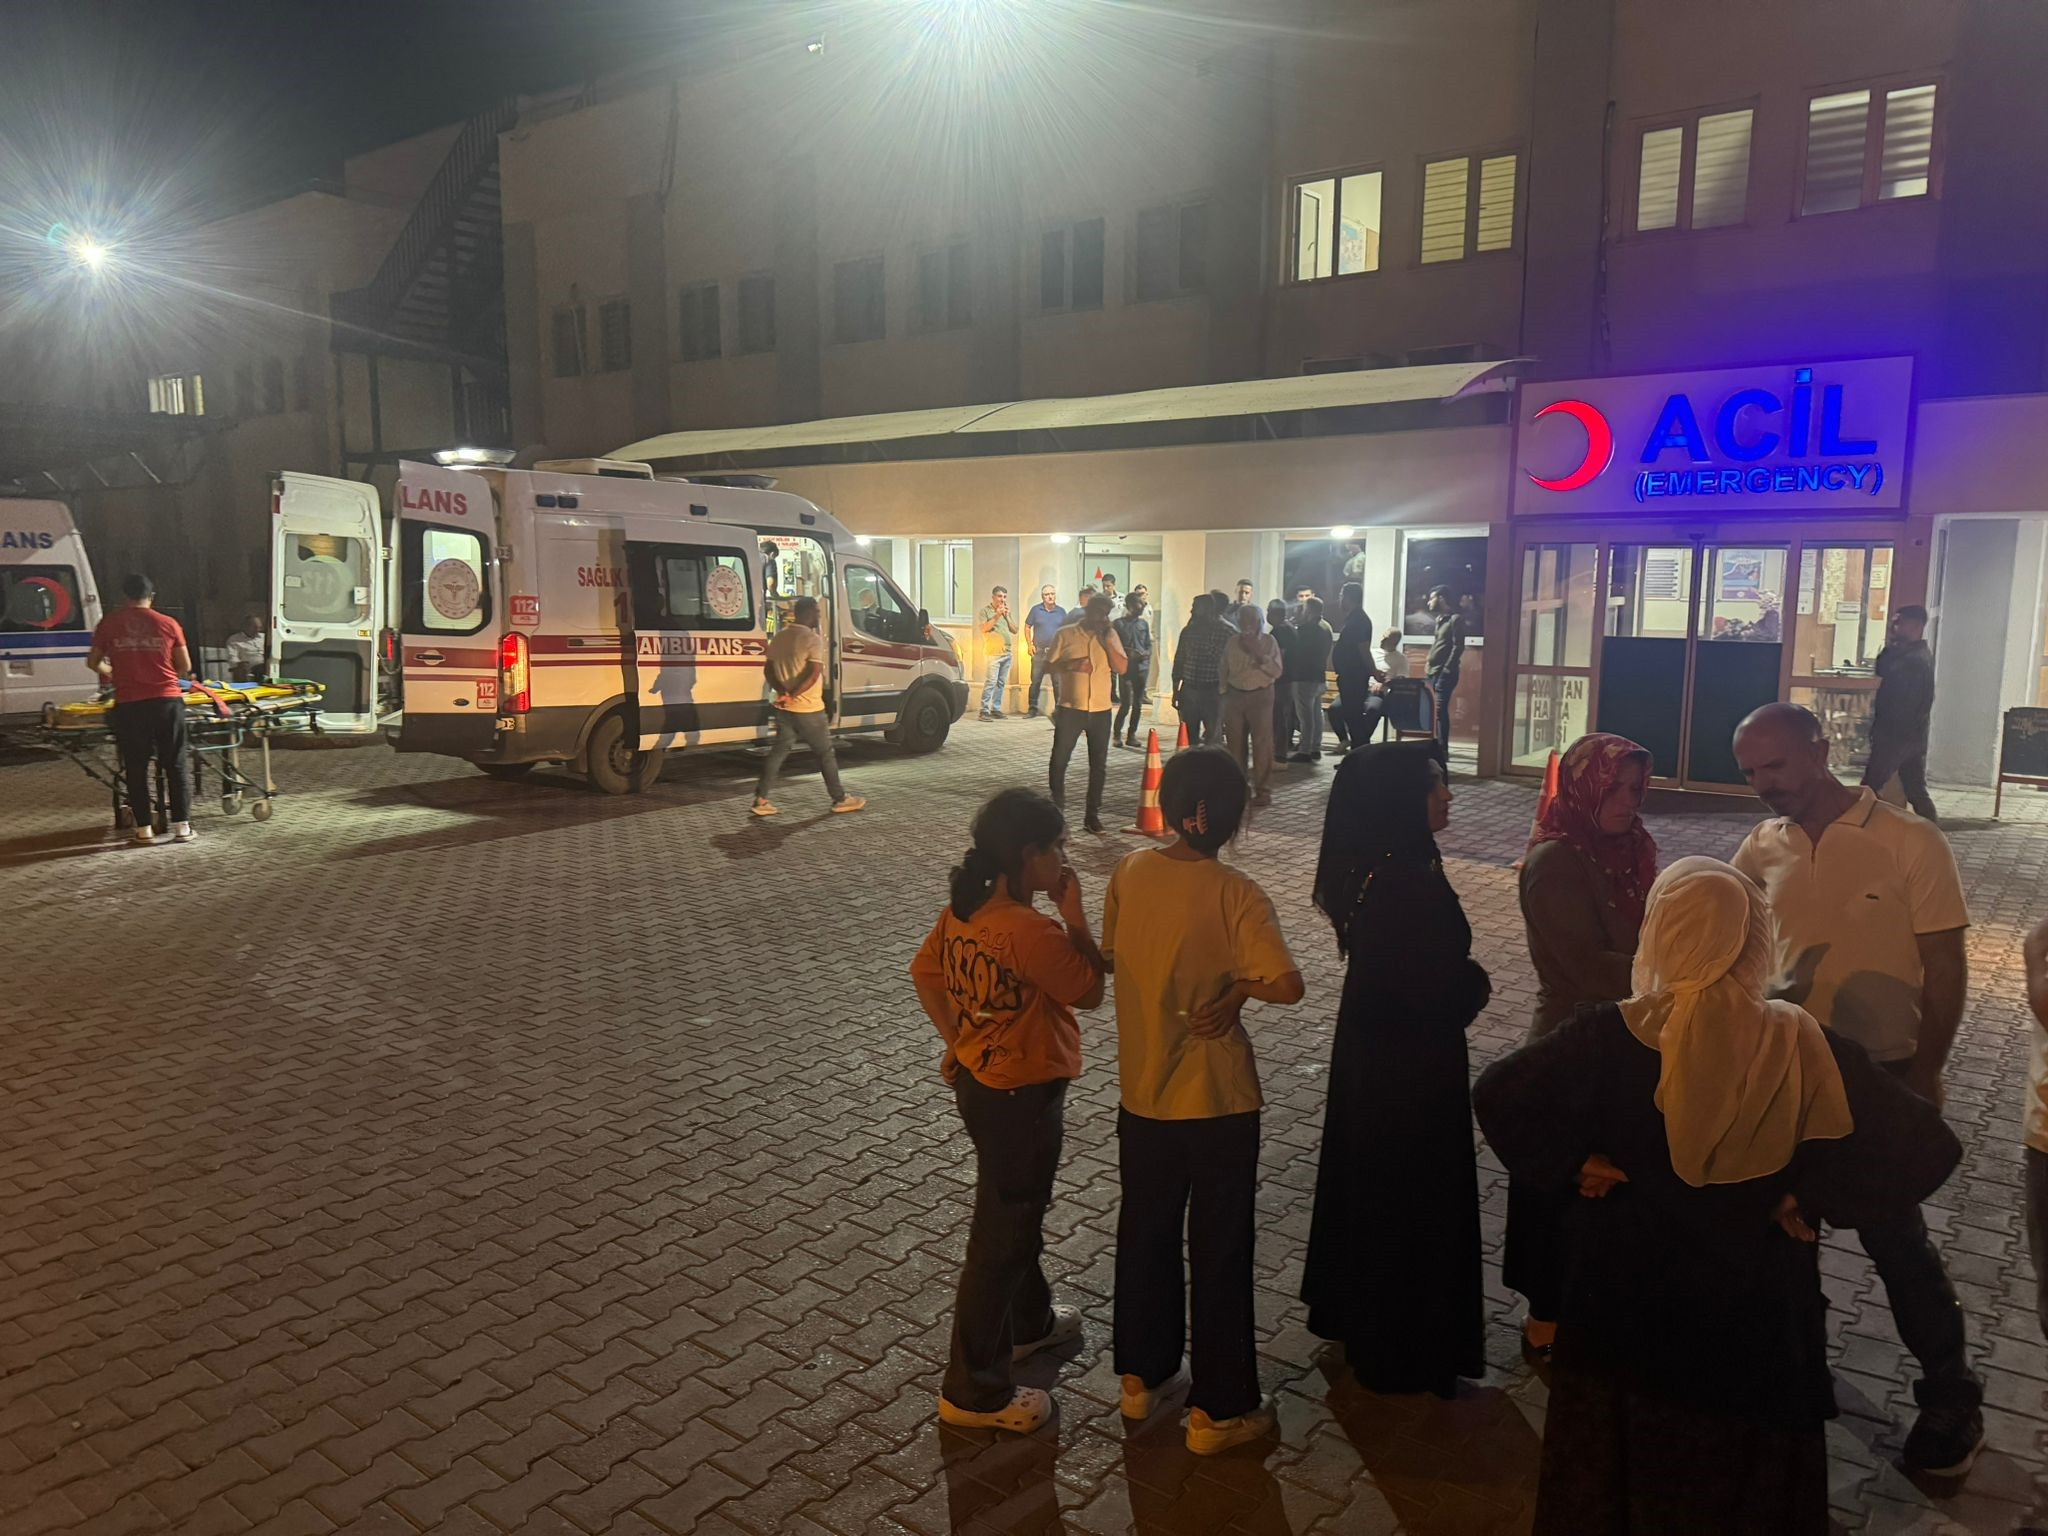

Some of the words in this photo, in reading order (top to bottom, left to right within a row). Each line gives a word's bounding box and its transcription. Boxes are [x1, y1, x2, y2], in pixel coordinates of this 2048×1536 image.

[1640, 367, 1878, 464] ACİL
[1634, 463, 1884, 503] (EMERGENCY)
[402, 485, 468, 516] LANS
[0, 531, 54, 549] ANS
[577, 563, 624, 587] SAĞLIK
[514, 600, 535, 613] 112
[639, 636, 743, 656] AMBULANS
[479, 682, 495, 697] 112
[1532, 679, 1584, 700] AYATAN
[1533, 700, 1570, 720] HATA
